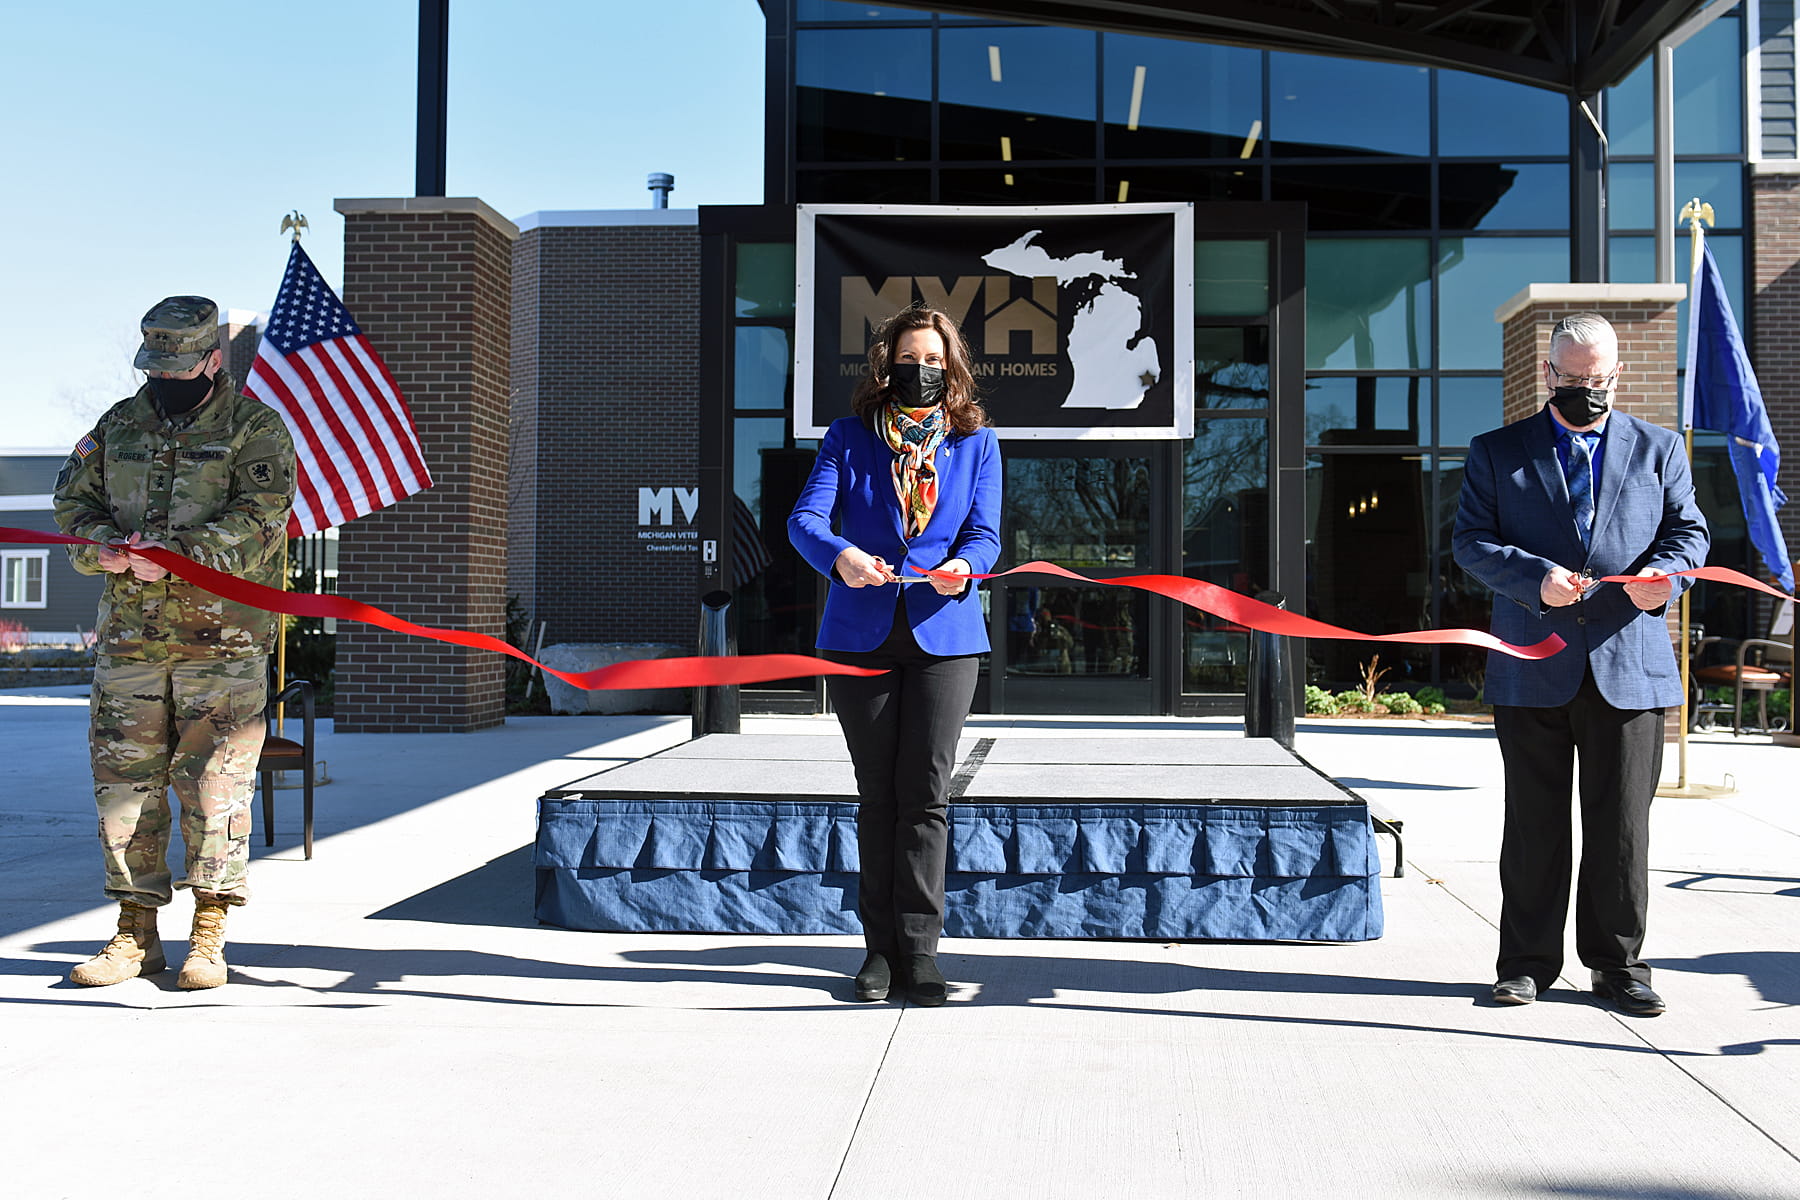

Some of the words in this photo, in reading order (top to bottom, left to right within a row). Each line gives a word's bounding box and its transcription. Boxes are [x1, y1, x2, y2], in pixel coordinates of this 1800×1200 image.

[1000, 362, 1057, 377] HOMES
[118, 451, 146, 461] ROGERS
[638, 531, 676, 539] MICHIGAN
